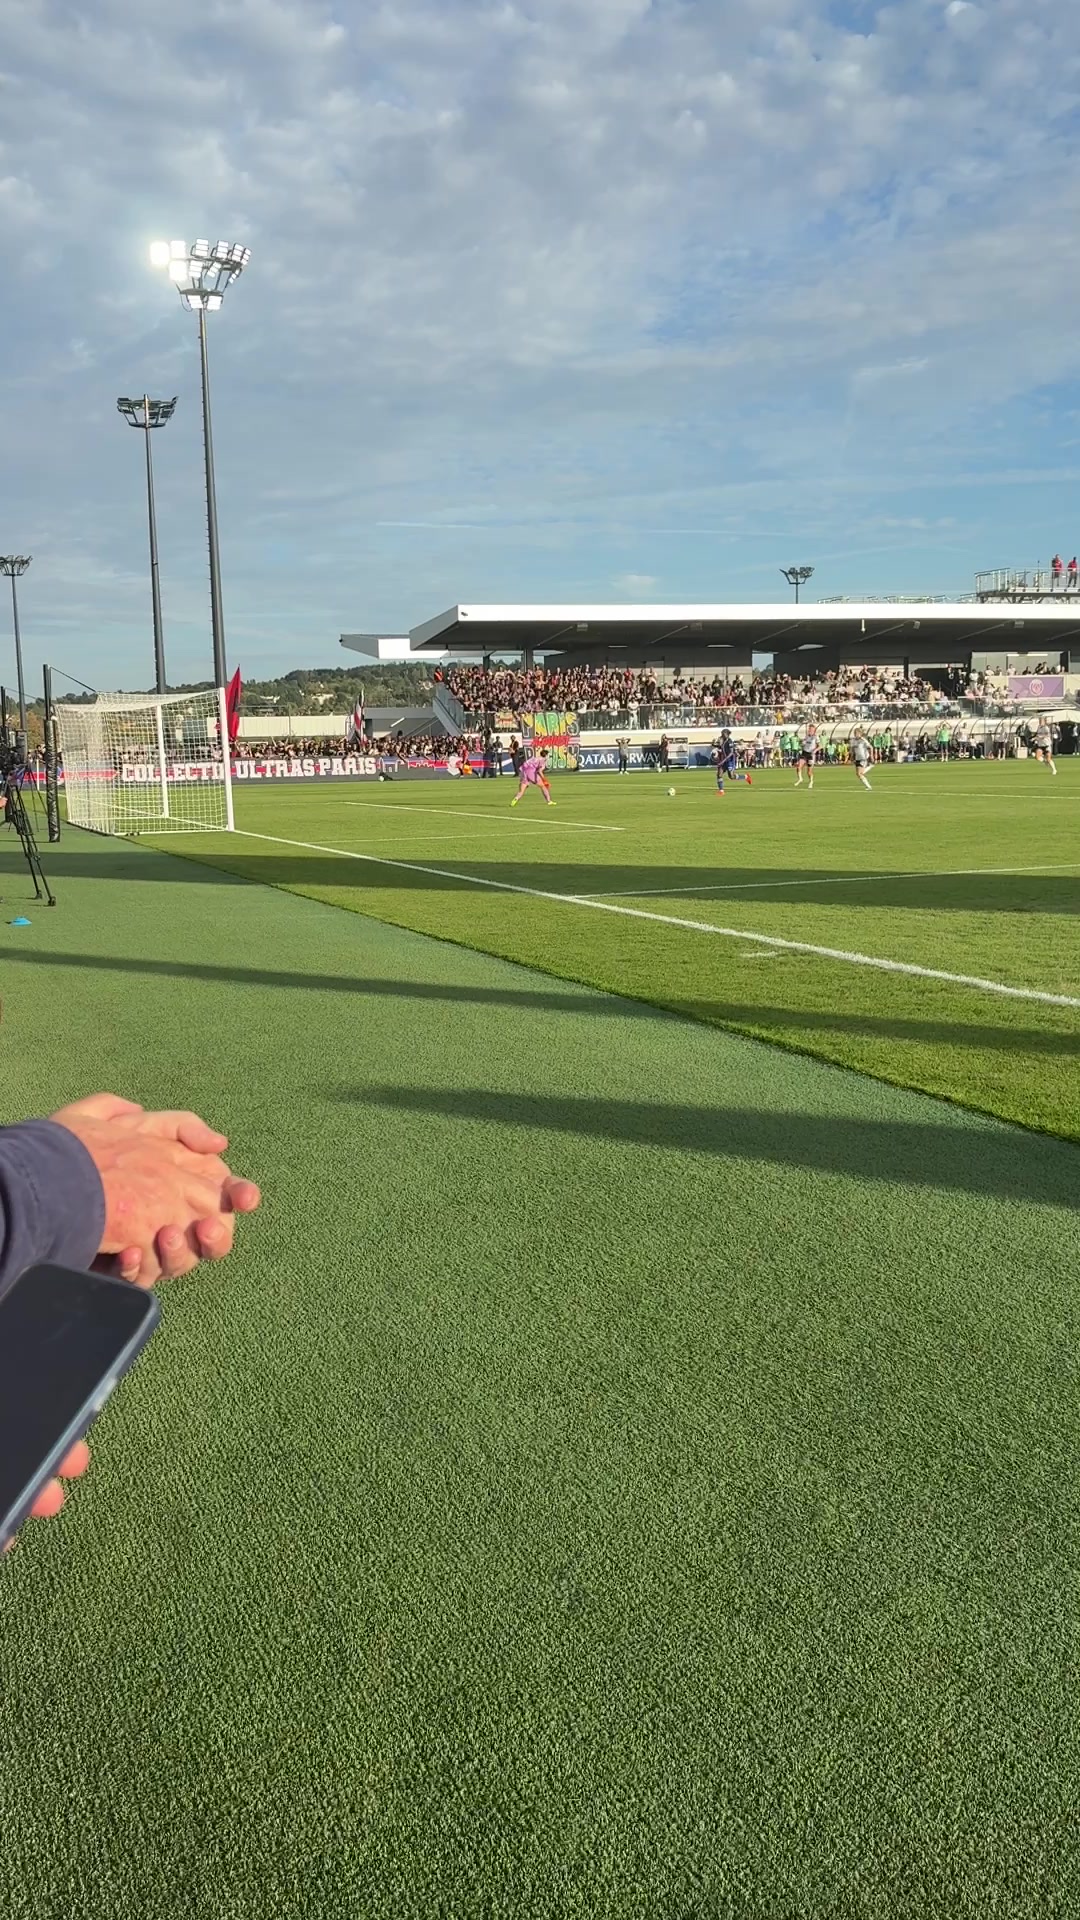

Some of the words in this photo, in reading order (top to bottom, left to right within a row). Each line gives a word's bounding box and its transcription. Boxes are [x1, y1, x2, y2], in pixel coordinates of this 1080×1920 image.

[235, 759, 315, 778] ULTRAS
[318, 757, 377, 776] PARIS
[524, 745, 579, 769] RCISM
[578, 753, 615, 767] QATAR
[617, 751, 661, 765] RWAY
